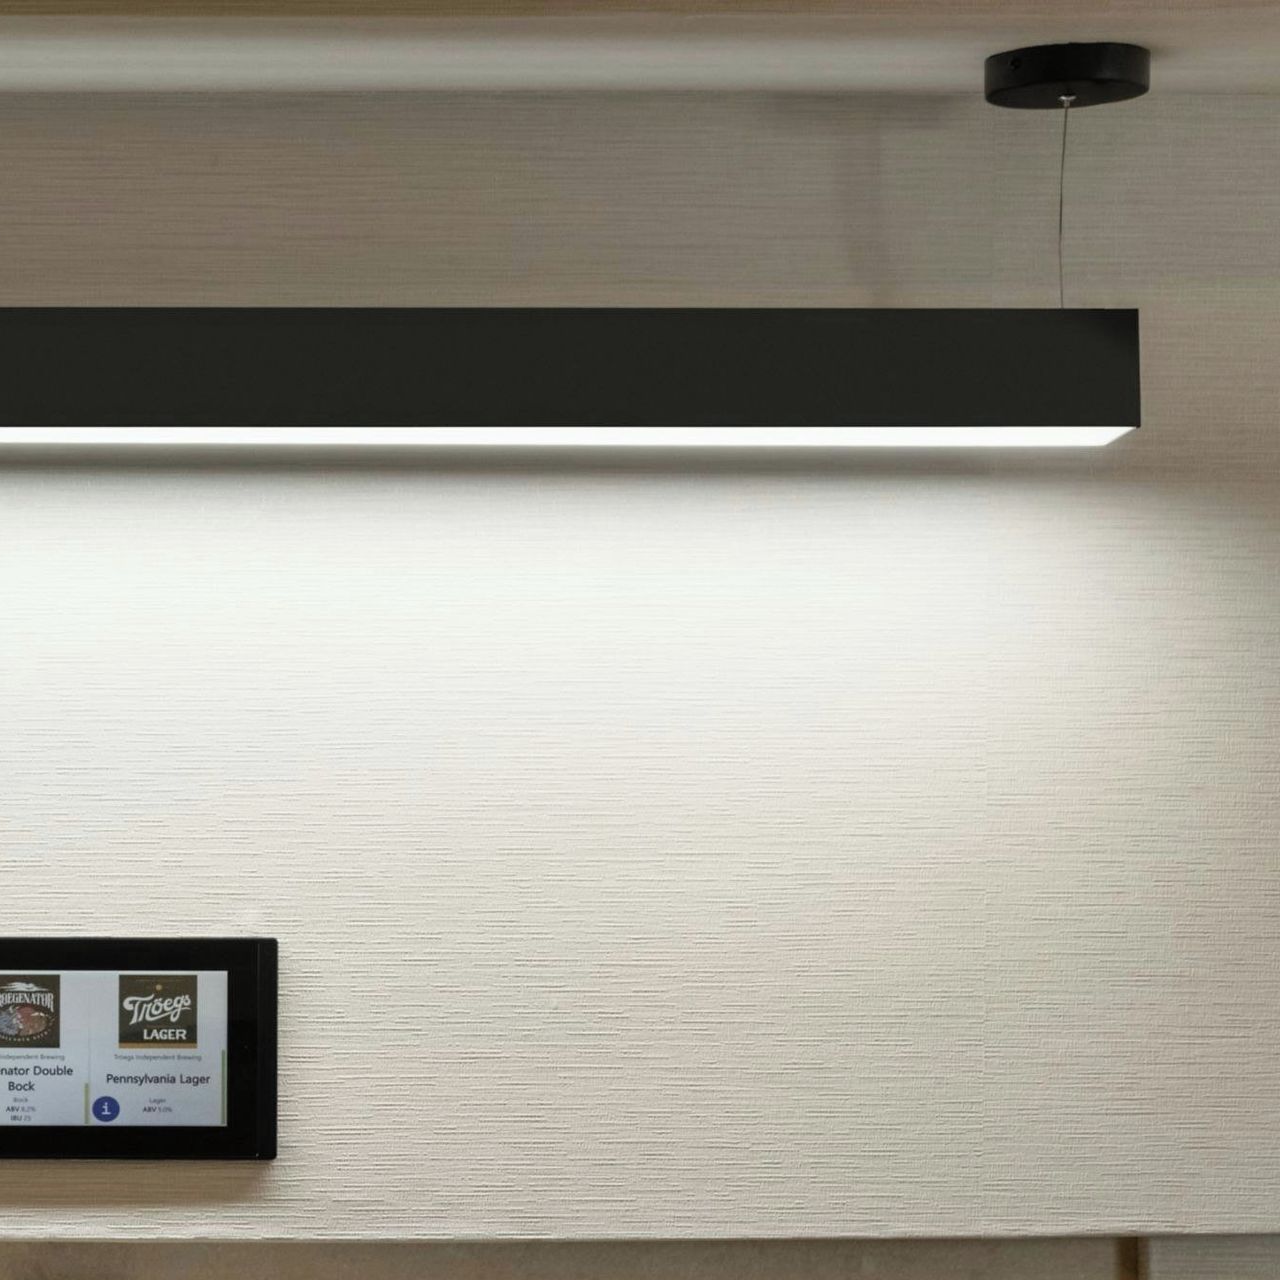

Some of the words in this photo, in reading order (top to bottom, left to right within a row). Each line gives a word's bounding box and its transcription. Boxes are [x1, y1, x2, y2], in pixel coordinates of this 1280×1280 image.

[123, 994, 192, 1025] Tröegs
[143, 1029, 187, 1040] LAGER
[33, 1065, 73, 1076] Double
[106, 1074, 176, 1086] Pennsylvania
[180, 1074, 211, 1086] Lager
[8, 1082, 35, 1091] Bock
